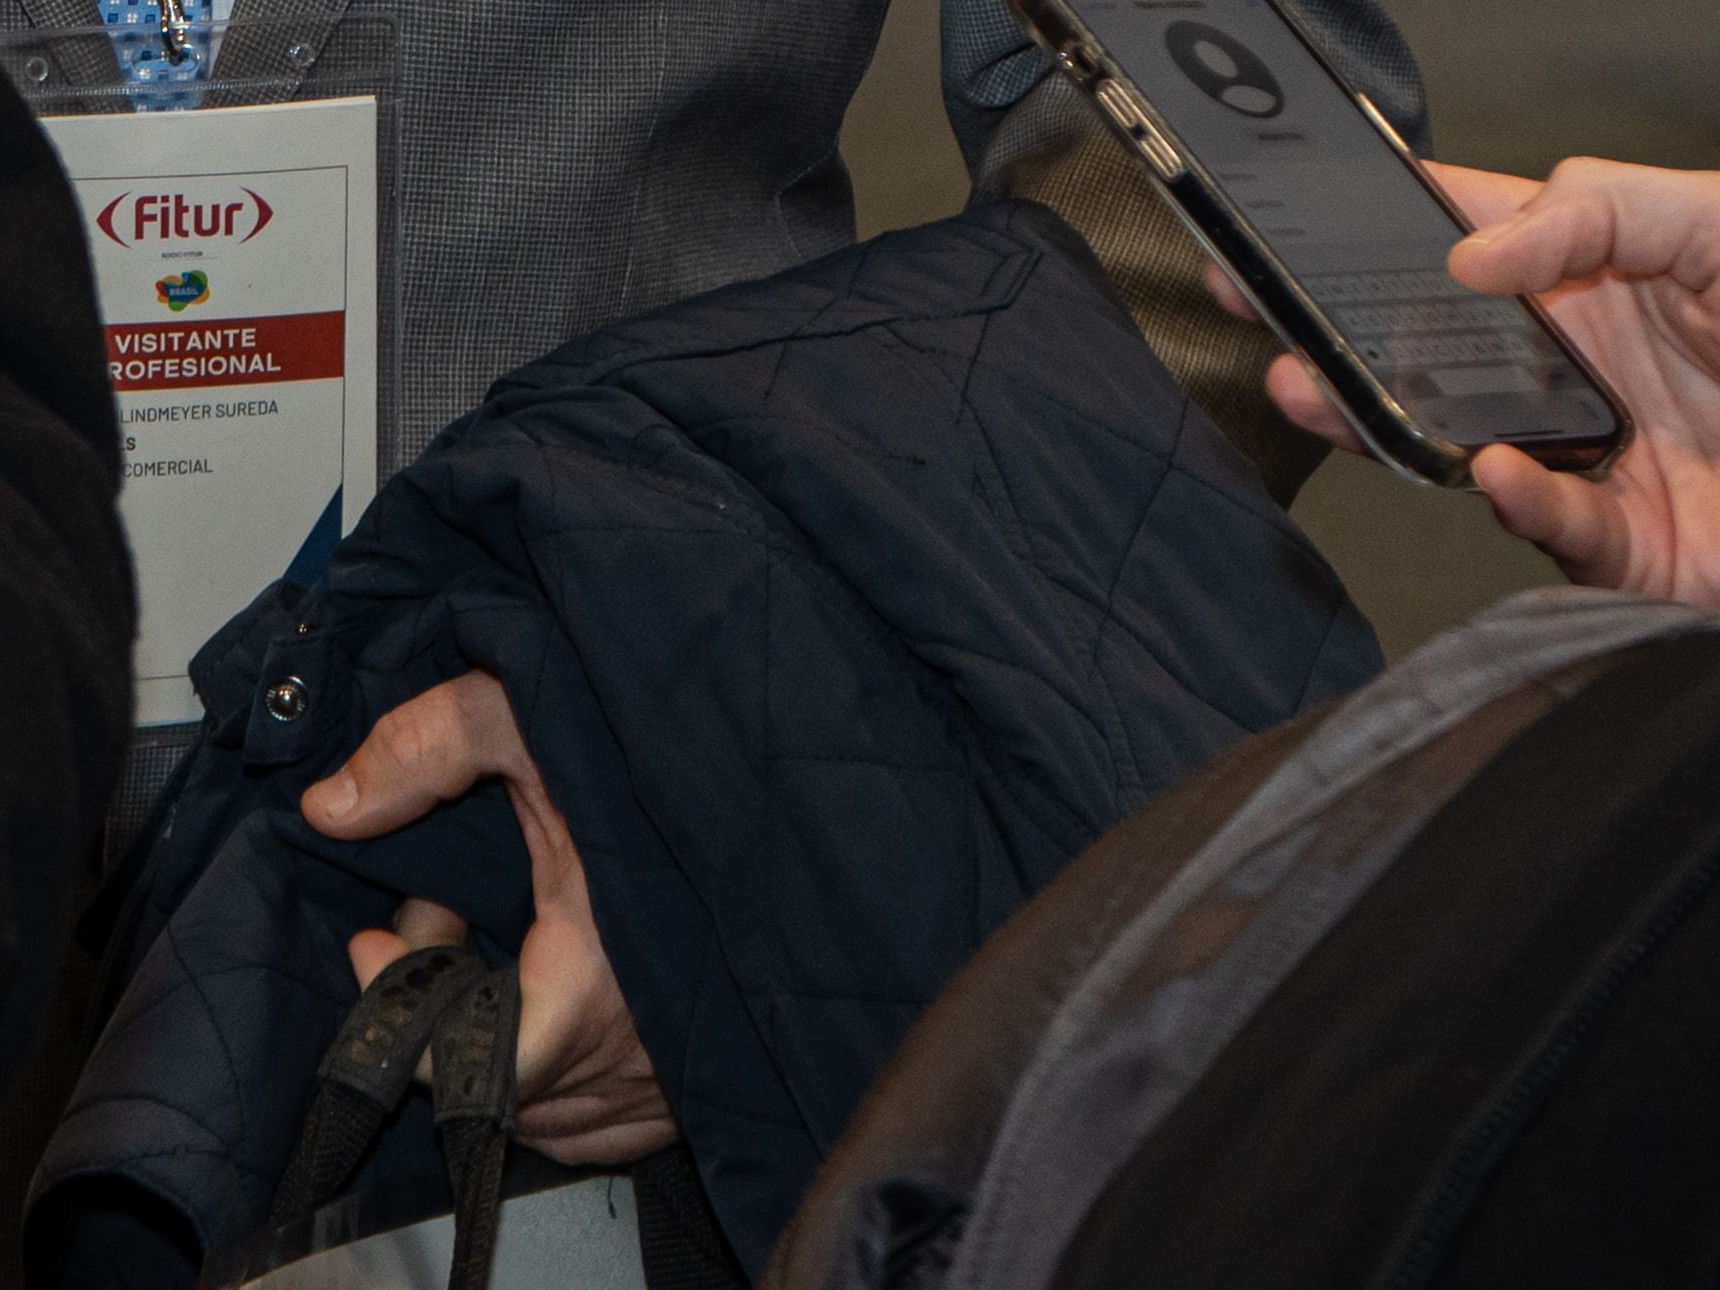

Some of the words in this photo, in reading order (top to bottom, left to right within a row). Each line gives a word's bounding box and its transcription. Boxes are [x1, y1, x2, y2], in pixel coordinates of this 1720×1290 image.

[169, 286, 199, 296] BRASIL
[114, 327, 257, 354] VISITANTE
[109, 352, 282, 380] ROFESIONAL
[120, 404, 212, 424] LINDMEYER
[215, 399, 279, 418] SUREDA
[124, 458, 214, 478] COMERCIAL
